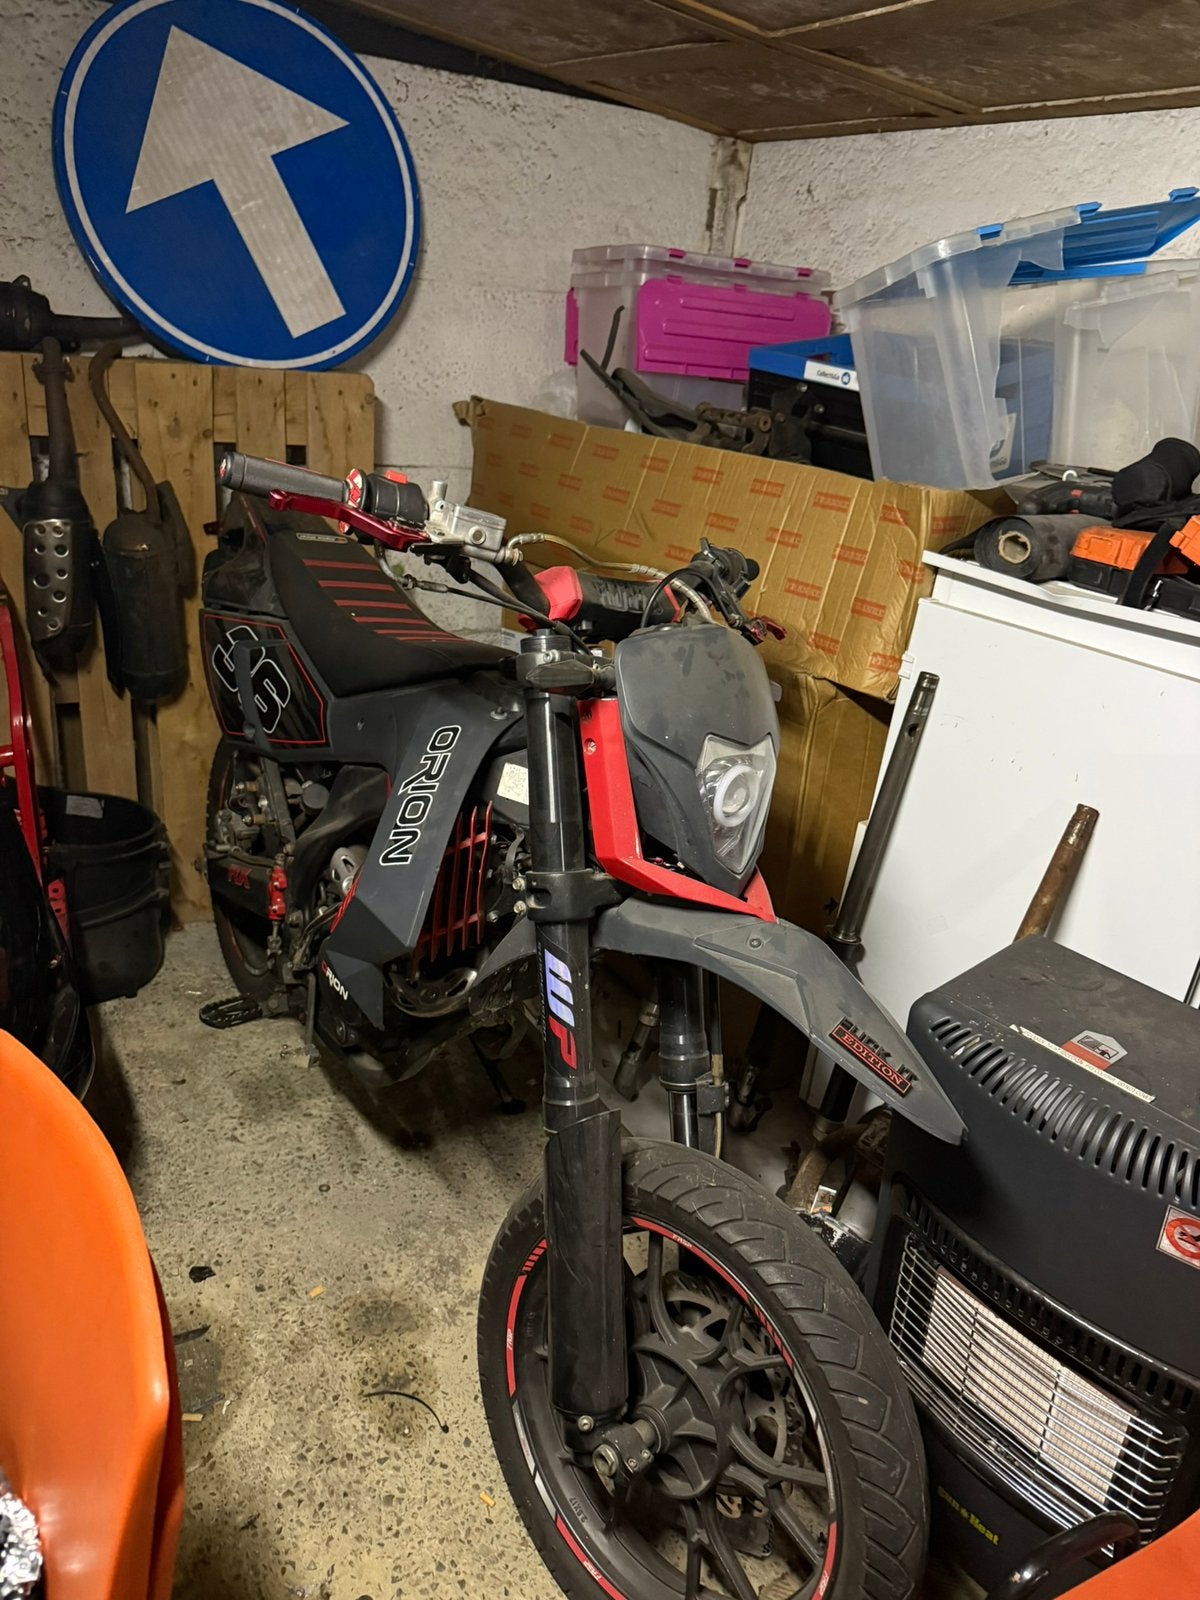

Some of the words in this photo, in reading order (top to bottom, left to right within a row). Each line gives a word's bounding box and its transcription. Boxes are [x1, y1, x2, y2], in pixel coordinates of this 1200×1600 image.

[379, 725, 462, 866] ORION
[321, 960, 349, 1000] ORION
[842, 1033, 904, 1085] EDITION
